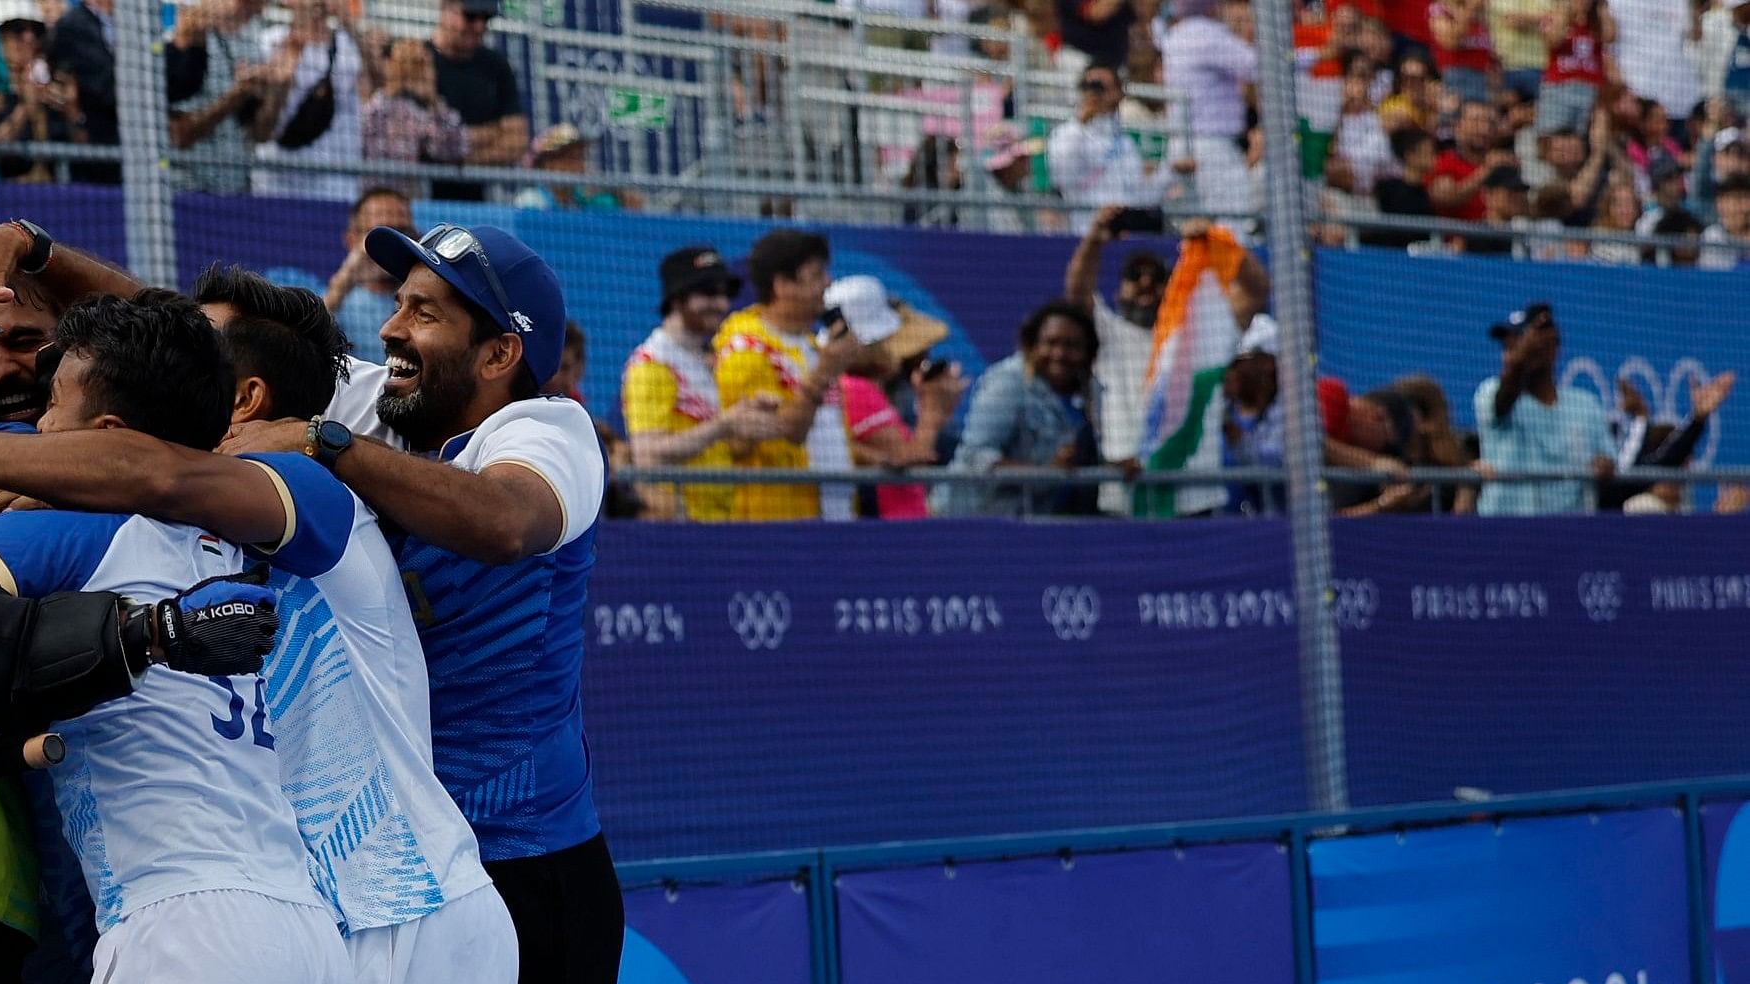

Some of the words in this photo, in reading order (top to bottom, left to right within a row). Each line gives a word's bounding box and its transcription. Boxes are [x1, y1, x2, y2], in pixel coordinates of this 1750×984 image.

[211, 602, 255, 619] KOBO
[593, 603, 685, 646] 2024
[164, 611, 176, 639] KOBO
